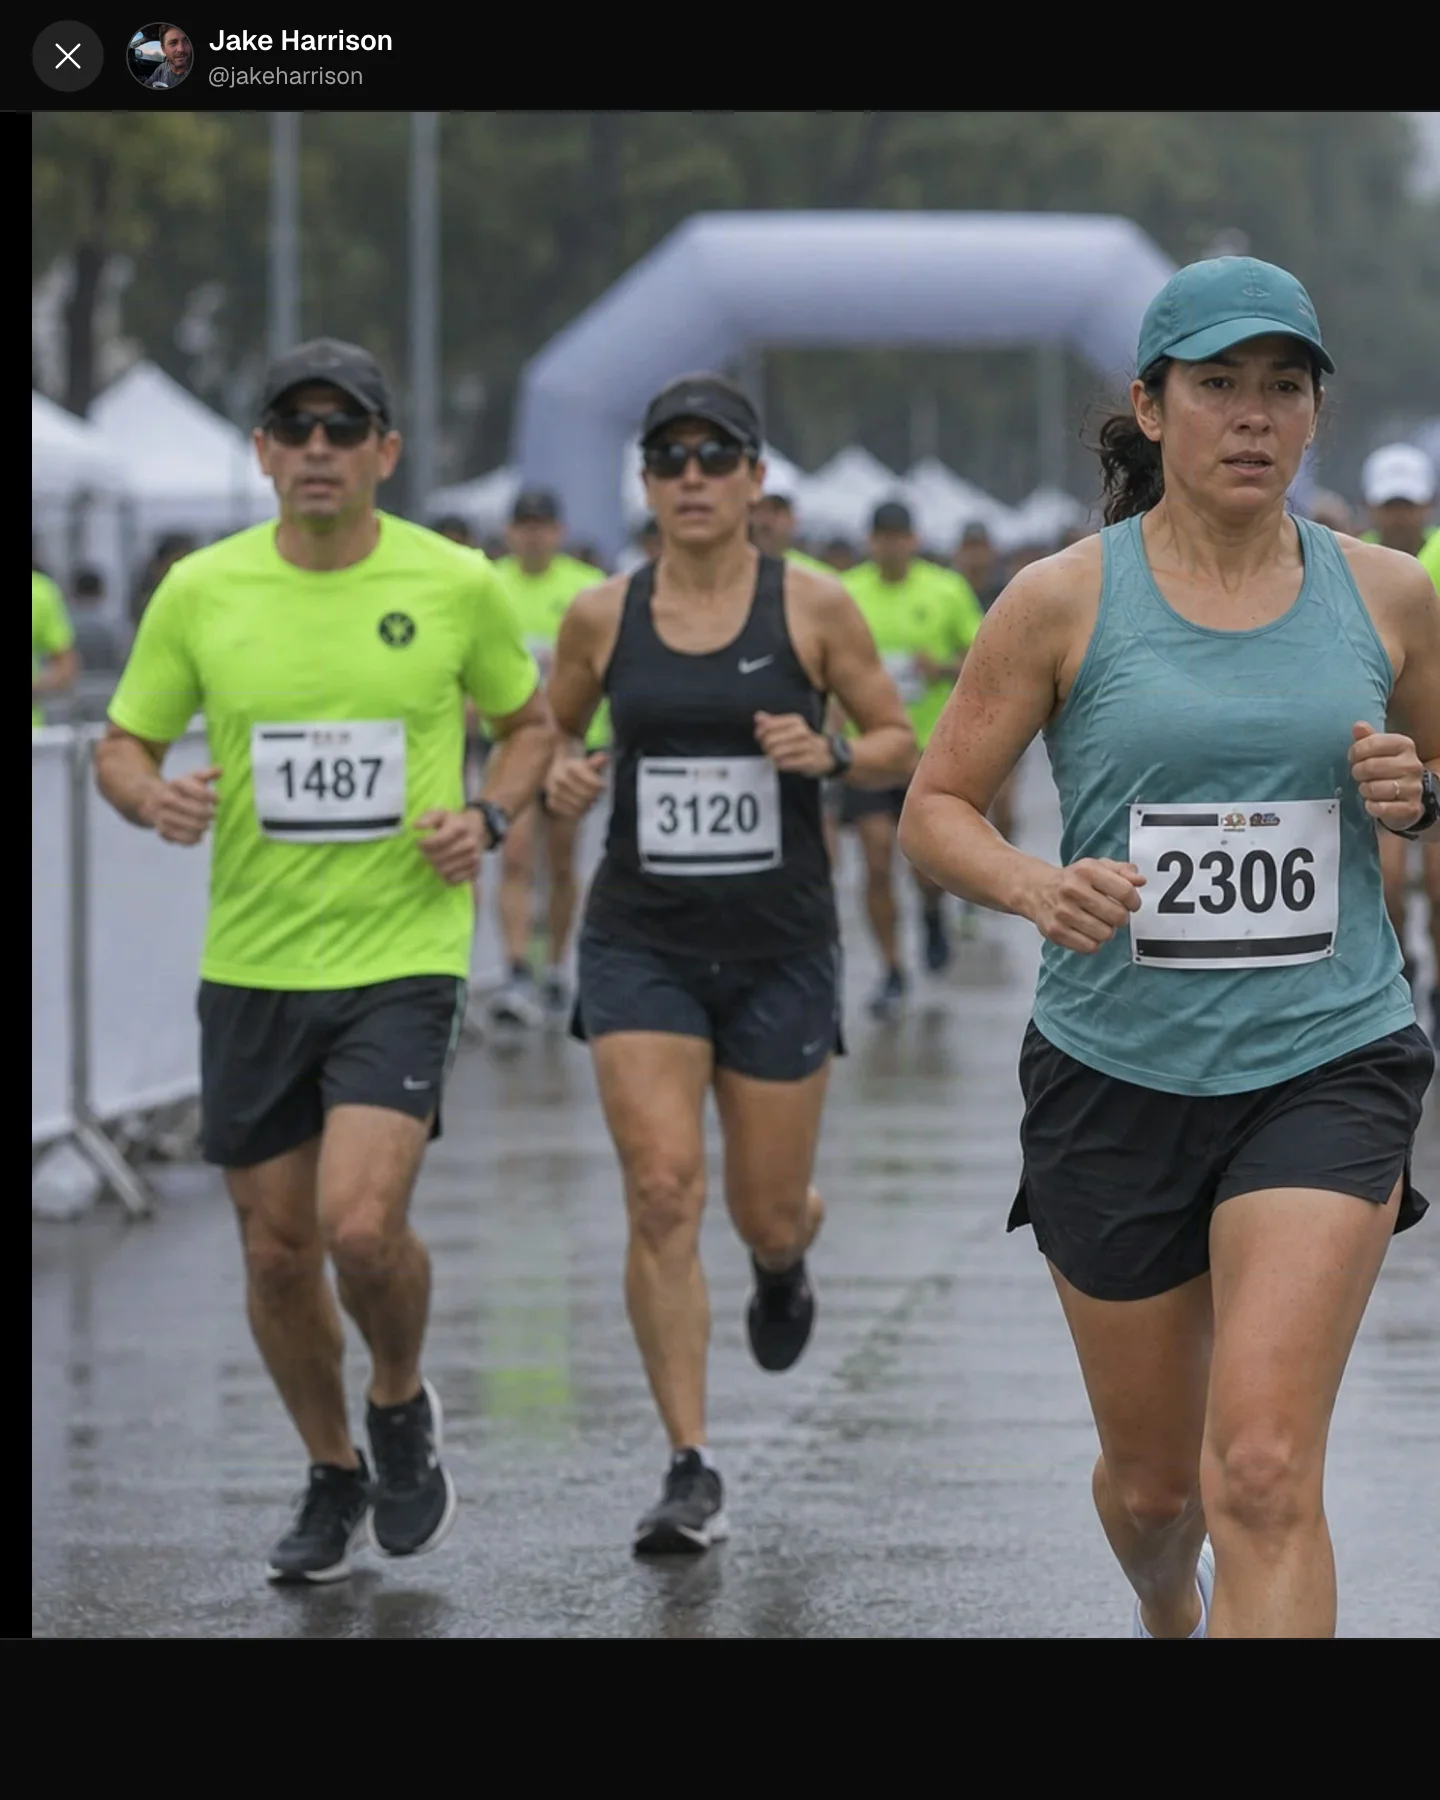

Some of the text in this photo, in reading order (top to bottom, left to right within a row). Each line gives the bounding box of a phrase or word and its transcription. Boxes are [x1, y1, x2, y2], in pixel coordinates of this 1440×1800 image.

[208, 29, 393, 52] Jake Harrison
[208, 66, 363, 89] @jakeharrison
[277, 757, 383, 801] 1487
[657, 792, 760, 836] 3120
[1156, 847, 1316, 915] 2306
